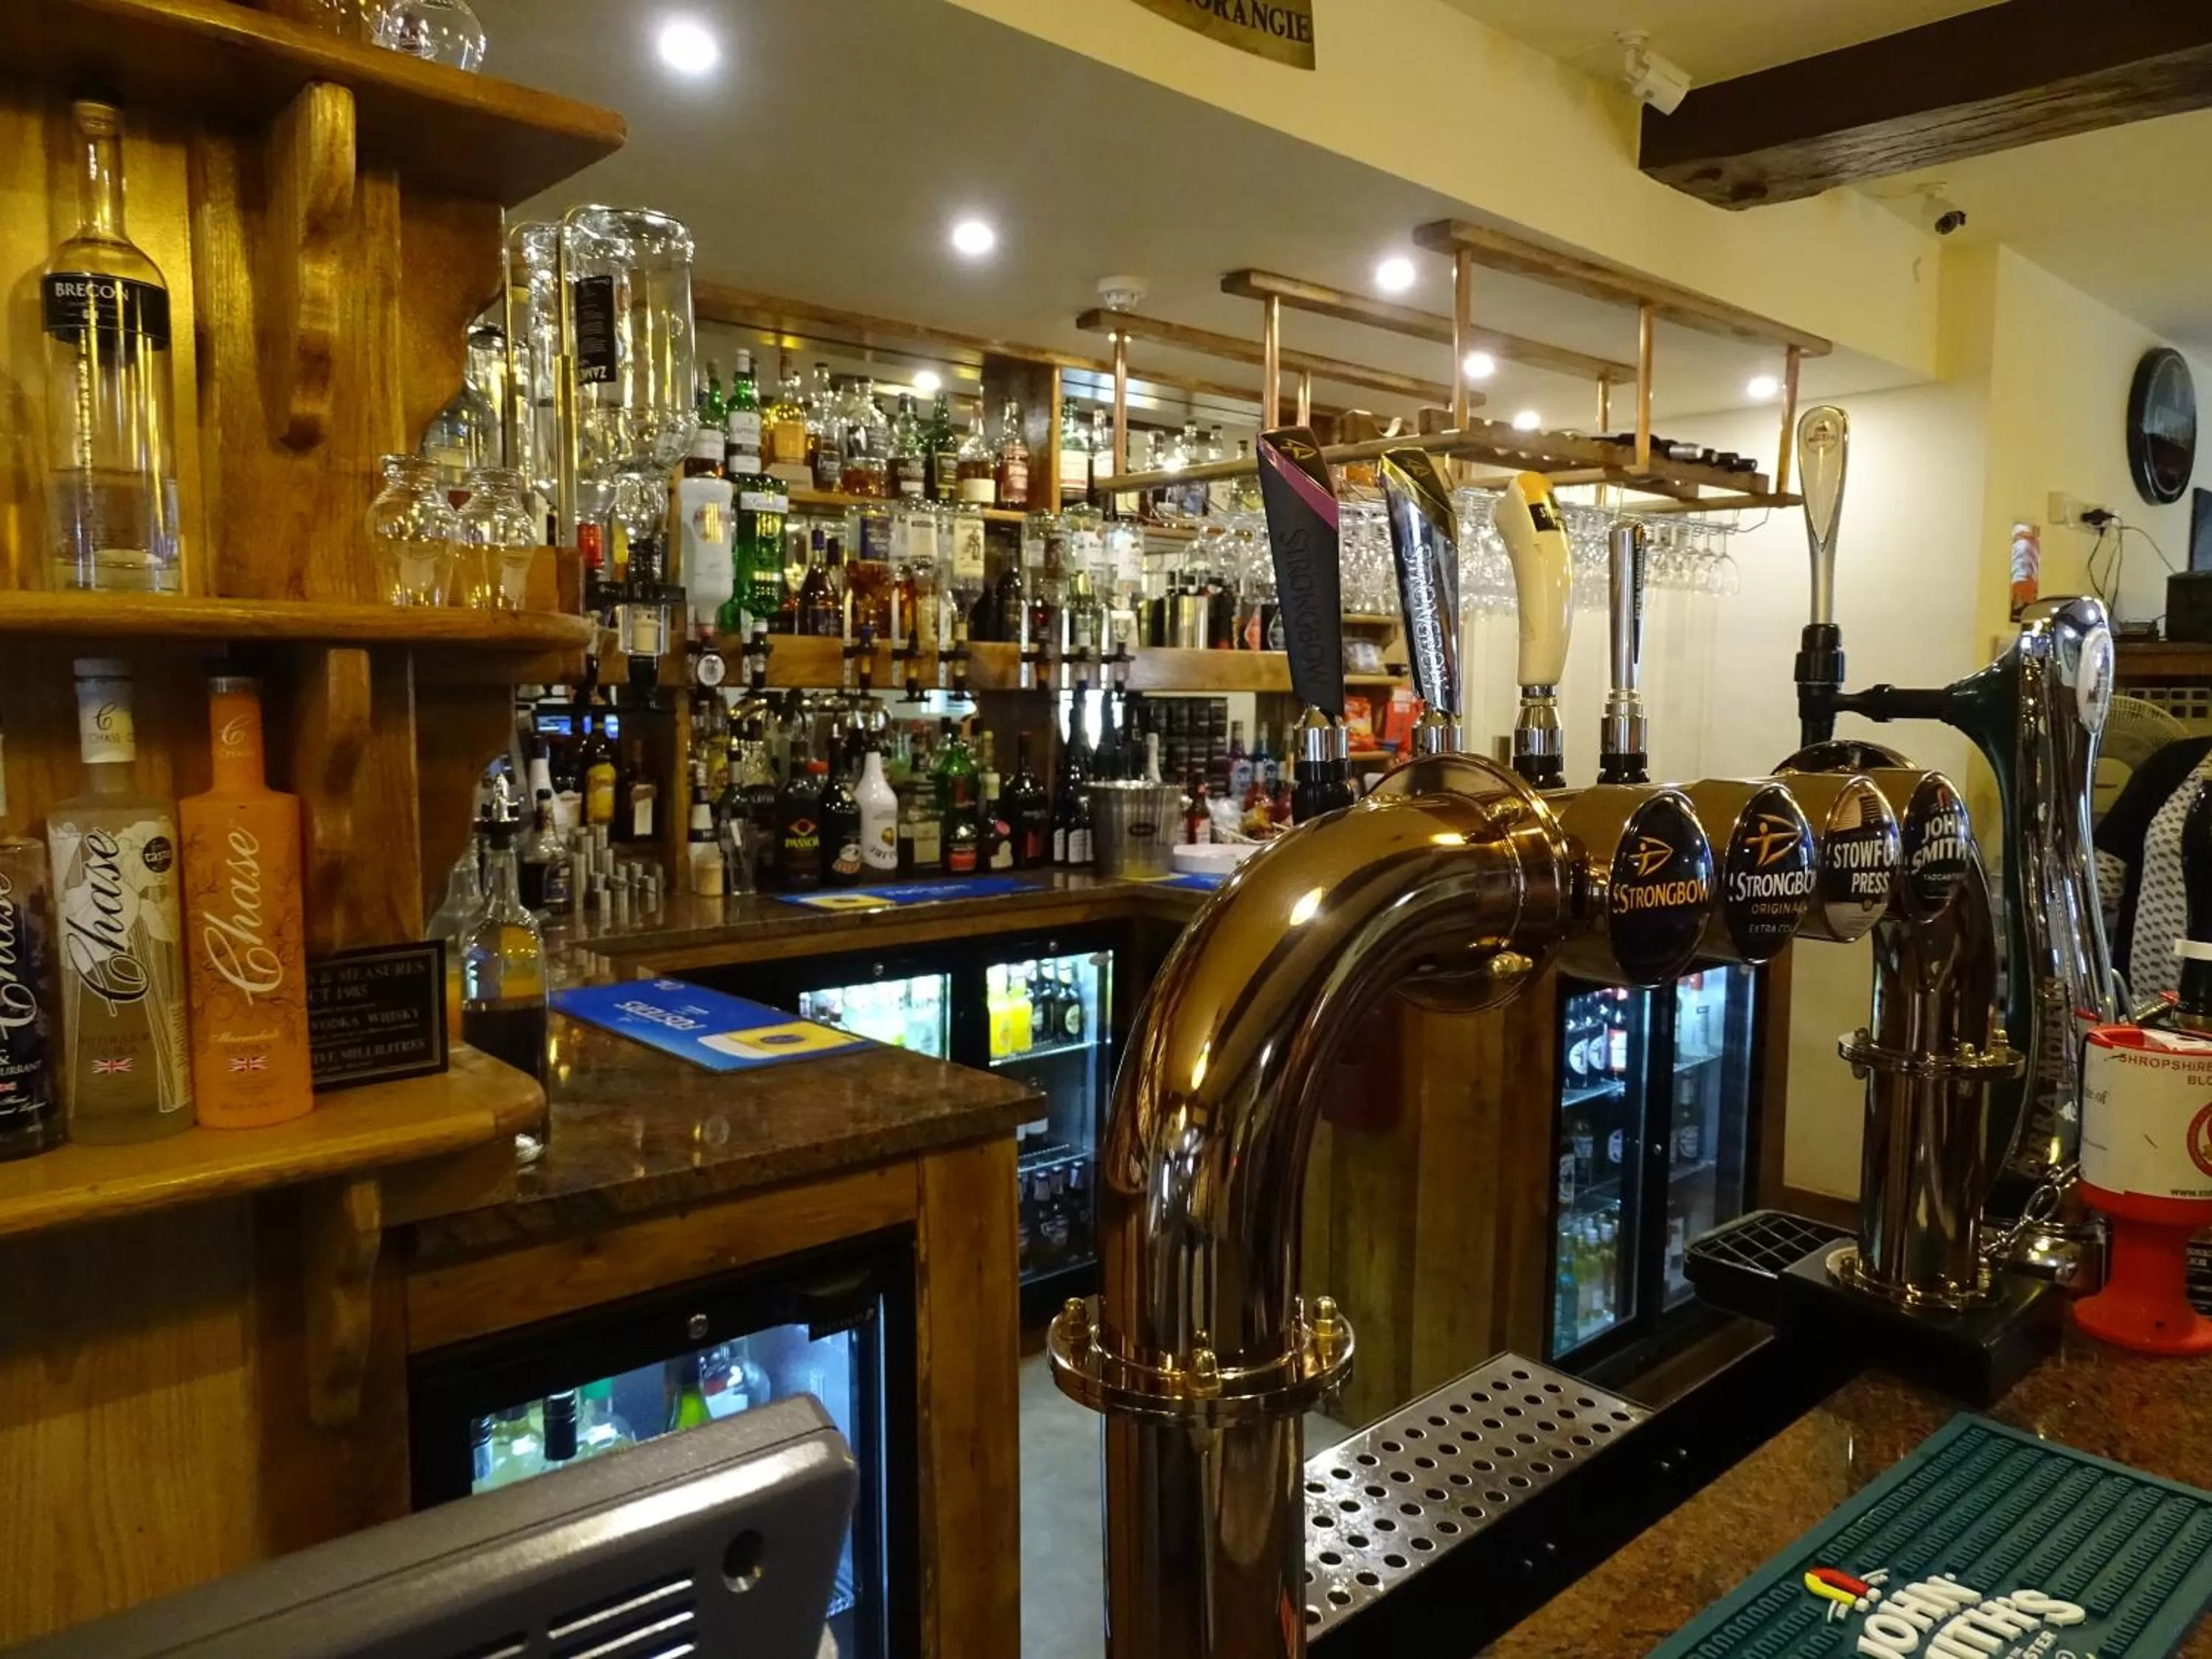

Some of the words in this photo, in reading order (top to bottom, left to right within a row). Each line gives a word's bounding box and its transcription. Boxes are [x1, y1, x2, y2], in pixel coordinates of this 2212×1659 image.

[55, 282, 129, 301] BRECON
[1619, 880, 1711, 914] STRONGBOW
[1851, 871, 1891, 894] PRESS
[65, 827, 149, 1018] Chase
[203, 824, 284, 1006] Chase
